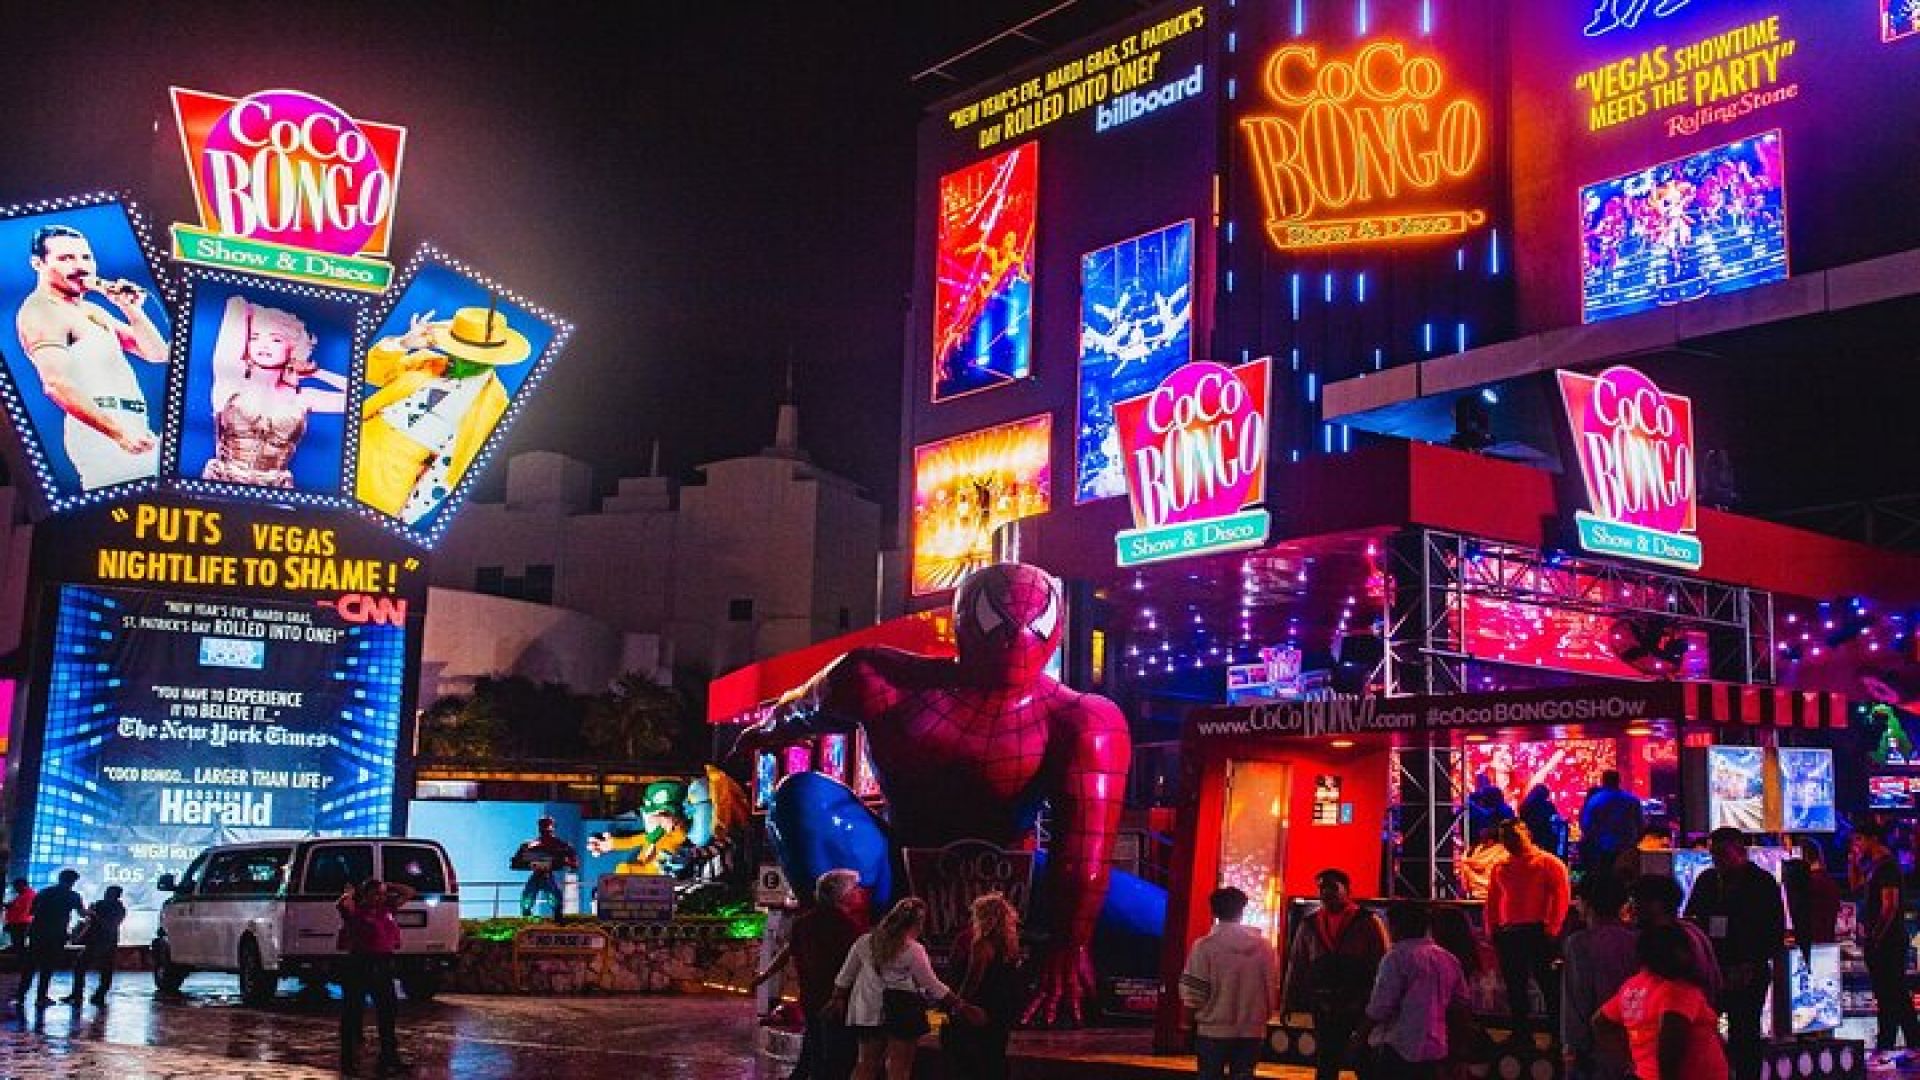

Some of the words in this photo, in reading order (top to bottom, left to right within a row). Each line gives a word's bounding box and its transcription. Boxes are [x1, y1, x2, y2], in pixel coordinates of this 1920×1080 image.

[980, 88, 1018, 117] YEAR'S
[1045, 59, 1083, 89] MARDI
[1121, 36, 1139, 59] ST.
[1141, 6, 1204, 50] PATRICK'S
[1575, 45, 1670, 102] "VEGAS
[1675, 15, 1780, 75] SHOWTIME
[1096, 64, 1204, 133] billboard
[1589, 96, 1647, 132] MEETS
[1651, 75, 1689, 111] THE
[1696, 40, 1796, 107] PARTY"
[979, 123, 1002, 149] DAY
[1004, 93, 1064, 140] ROLLED
[1068, 73, 1108, 114] INTO
[1240, 99, 1481, 220] BONGO
[203, 147, 391, 238] BONGO
[1288, 225, 1350, 247] Show
[1385, 216, 1451, 237] Disco
[197, 238, 267, 267] Show
[276, 251, 297, 271] &
[304, 256, 374, 283] Disco
[1133, 411, 1264, 528] BONGO
[1584, 425, 1689, 522] BONGO
[252, 523, 336, 556] VEGAS
[1132, 535, 1178, 556] Show
[1183, 528, 1196, 548] &
[1203, 521, 1254, 545] Disco
[1591, 523, 1633, 547] Show
[1637, 535, 1649, 551] &
[1653, 536, 1692, 559] Disco
[98, 548, 238, 586] NIGHTLIFE
[242, 557, 278, 587] TO
[122, 615, 137, 629] ST.
[140, 616, 190, 632] PATRICK'S
[192, 620, 211, 634] DAY
[213, 618, 265, 638] ROLLED
[269, 623, 302, 642] INTO
[195, 603, 228, 617] YEAR'S
[253, 608, 284, 622] MARDI
[170, 703, 181, 716] IT
[183, 704, 198, 718] TO
[199, 703, 250, 721] BELIEVE
[181, 687, 209, 701] HAVE
[211, 689, 225, 702] TO
[226, 687, 302, 708] EXPERIENCE
[117, 717, 158, 740] The
[159, 719, 208, 742] New
[209, 722, 263, 747] York
[264, 725, 331, 748] Times
[104, 767, 139, 782] "COCO
[194, 767, 249, 785] LARGER
[253, 769, 289, 788] THAN
[160, 788, 273, 827] Herald
[103, 862, 145, 883] Los
